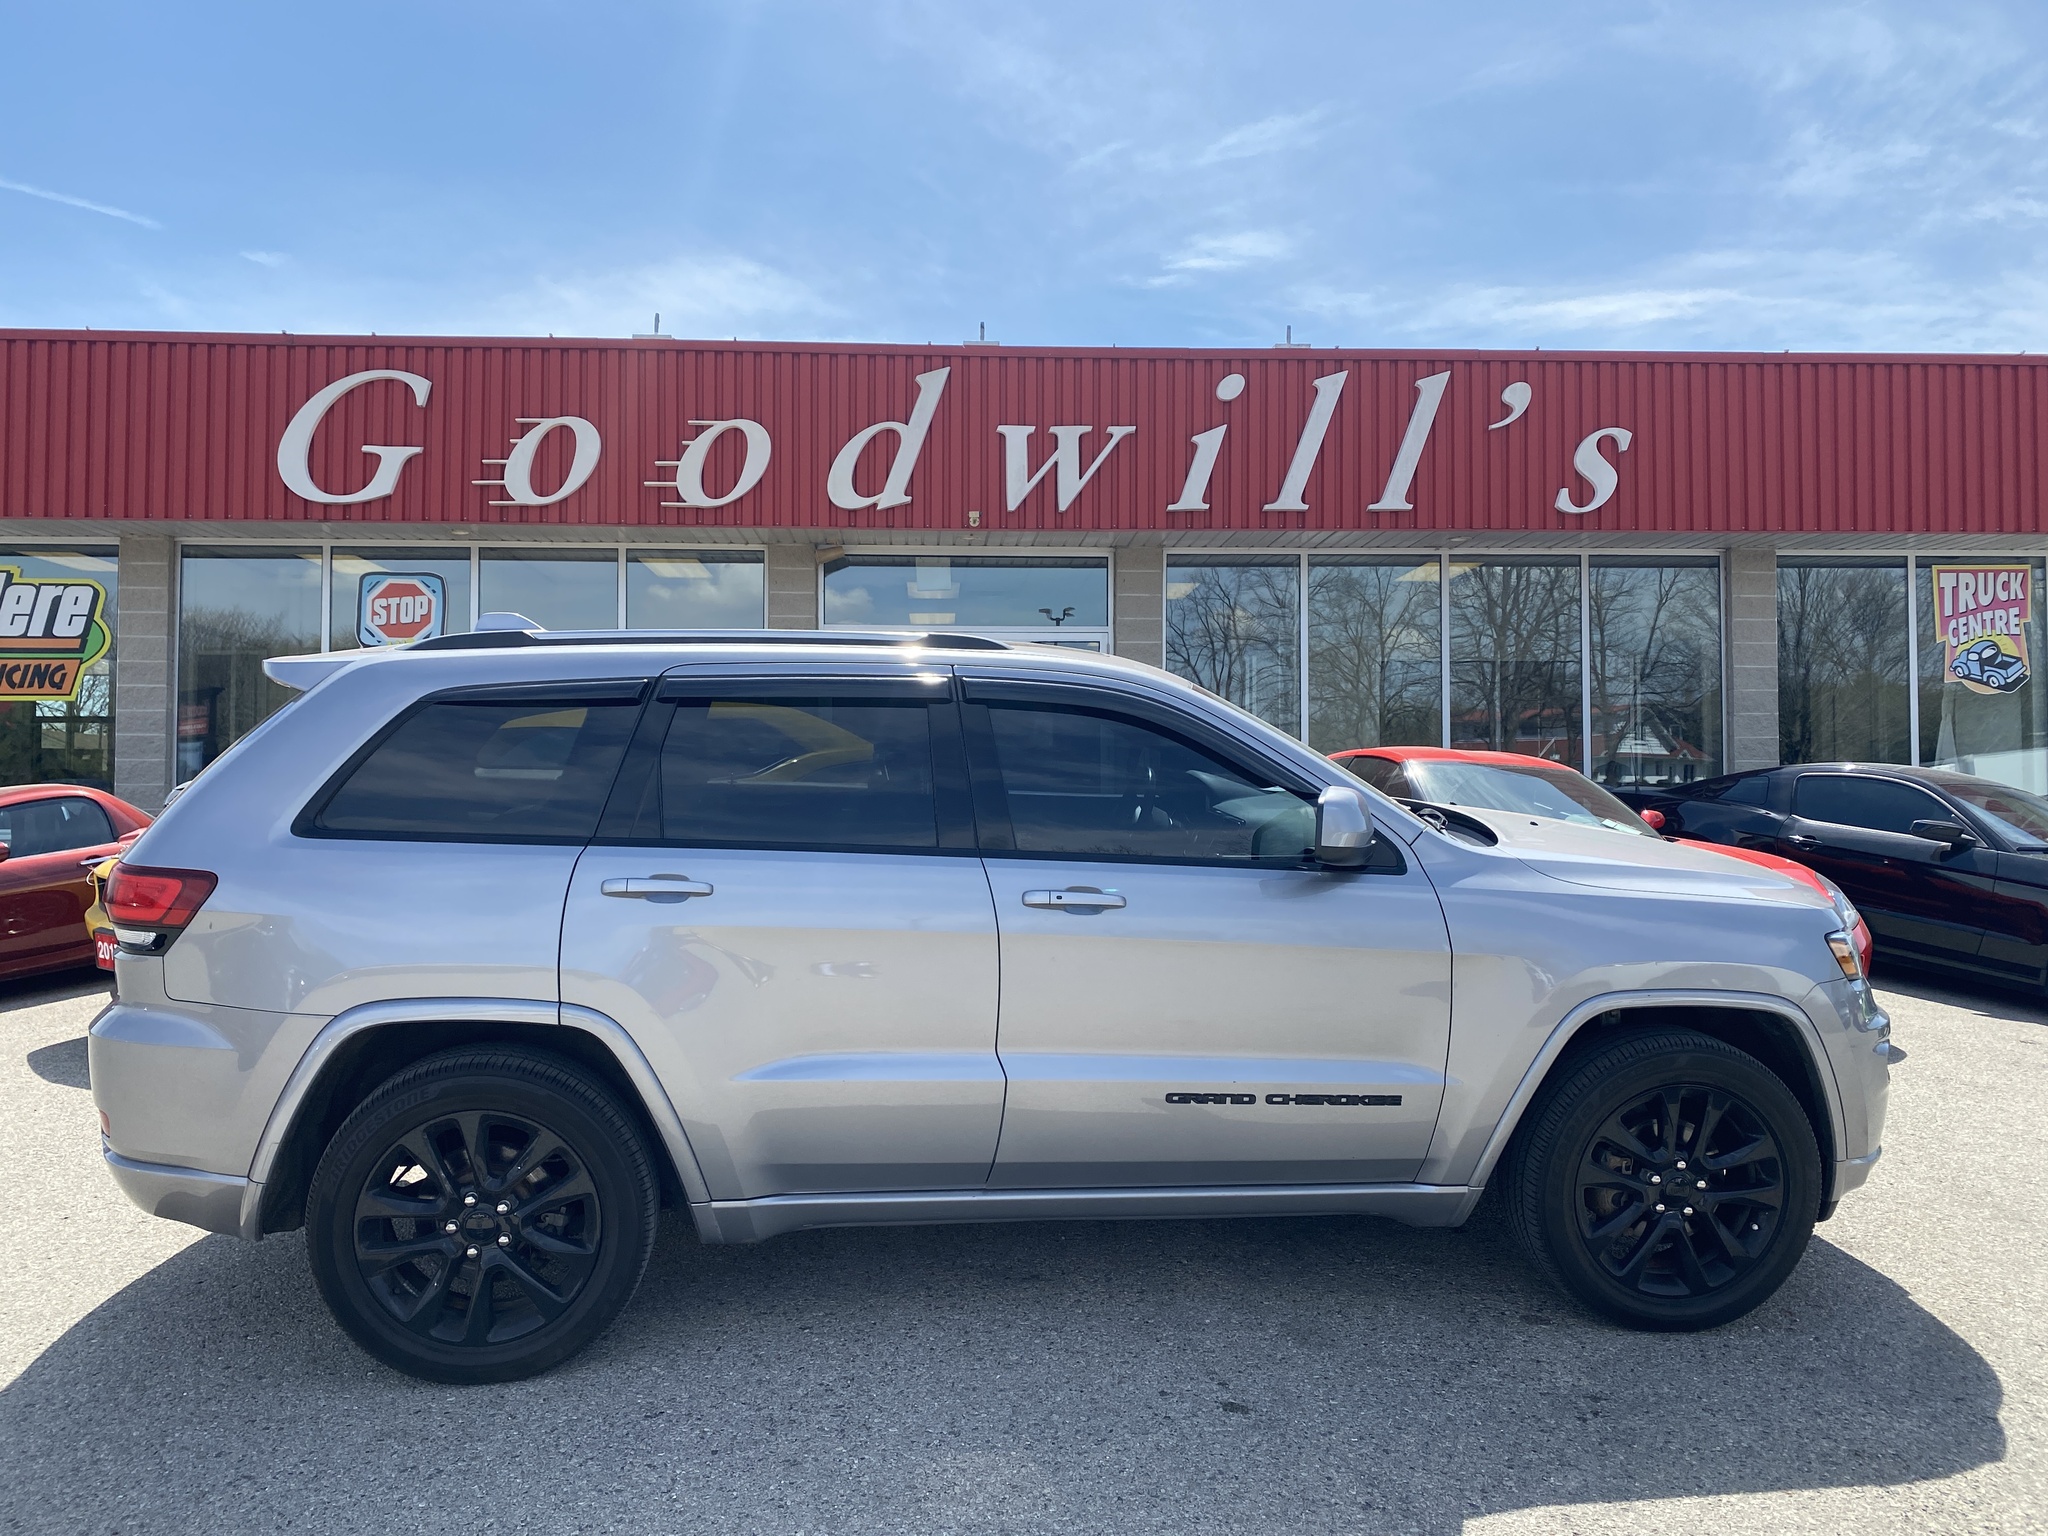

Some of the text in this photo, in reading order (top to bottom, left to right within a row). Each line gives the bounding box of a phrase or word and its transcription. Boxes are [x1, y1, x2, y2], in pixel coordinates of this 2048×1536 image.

[277, 366, 1633, 515] Goodwill's
[372, 595, 429, 626] STOP
[1939, 571, 2025, 617] TRUCK
[1947, 606, 2021, 648] CENTRE
[97, 941, 114, 960] 201
[1165, 1092, 1402, 1106] GRAND CHEROKEE
